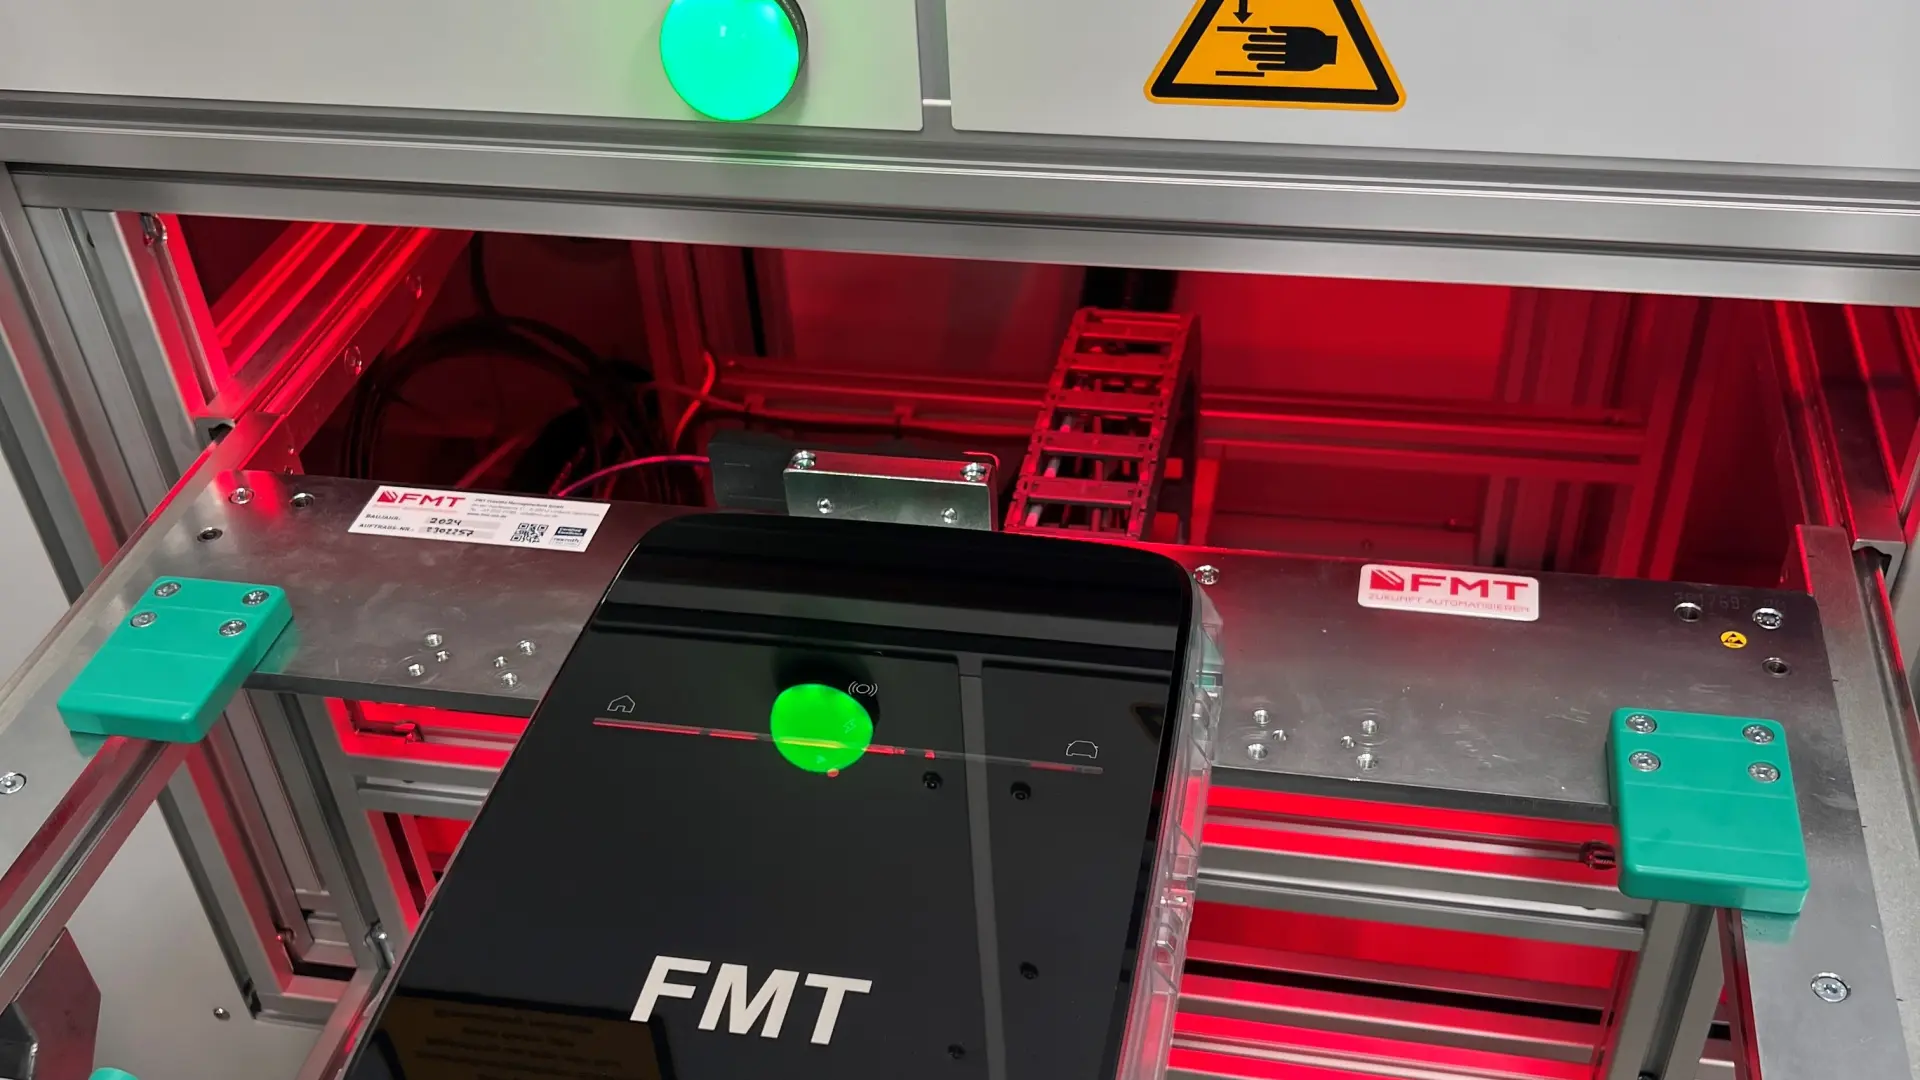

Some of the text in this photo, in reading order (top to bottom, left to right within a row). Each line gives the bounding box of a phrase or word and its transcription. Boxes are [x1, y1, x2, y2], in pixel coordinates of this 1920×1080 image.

[397, 492, 467, 508] FMT
[429, 517, 462, 526] 2024
[1410, 573, 1529, 600] FMT
[1368, 592, 1422, 604] ZUKUNFT
[629, 955, 873, 1046] FMT
